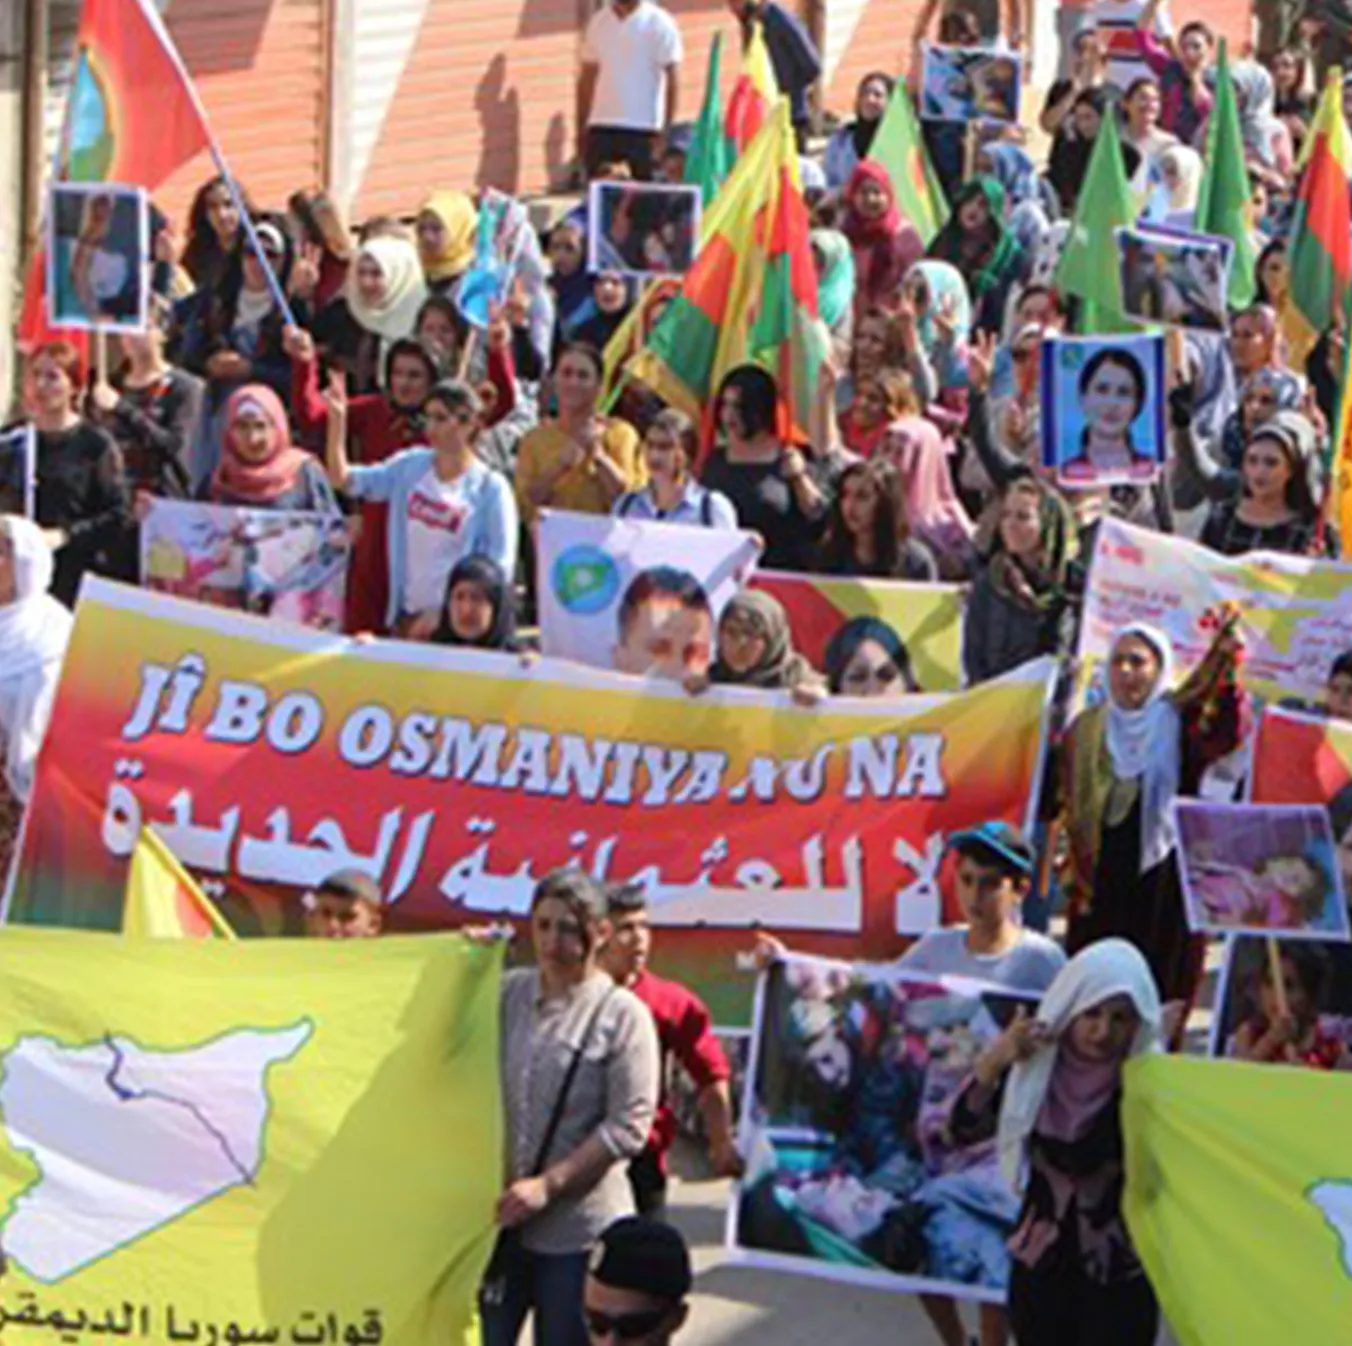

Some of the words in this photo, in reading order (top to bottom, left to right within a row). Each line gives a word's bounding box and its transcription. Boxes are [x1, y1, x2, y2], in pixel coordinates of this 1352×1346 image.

[124, 652, 206, 741] JÎ
[205, 680, 323, 753] BO
[339, 704, 728, 808] OSMANIYA
[844, 732, 949, 801] NA
[101, 755, 436, 904] الجديدة
[892, 830, 946, 936] لا
[290, 1308, 384, 1345] قوات
